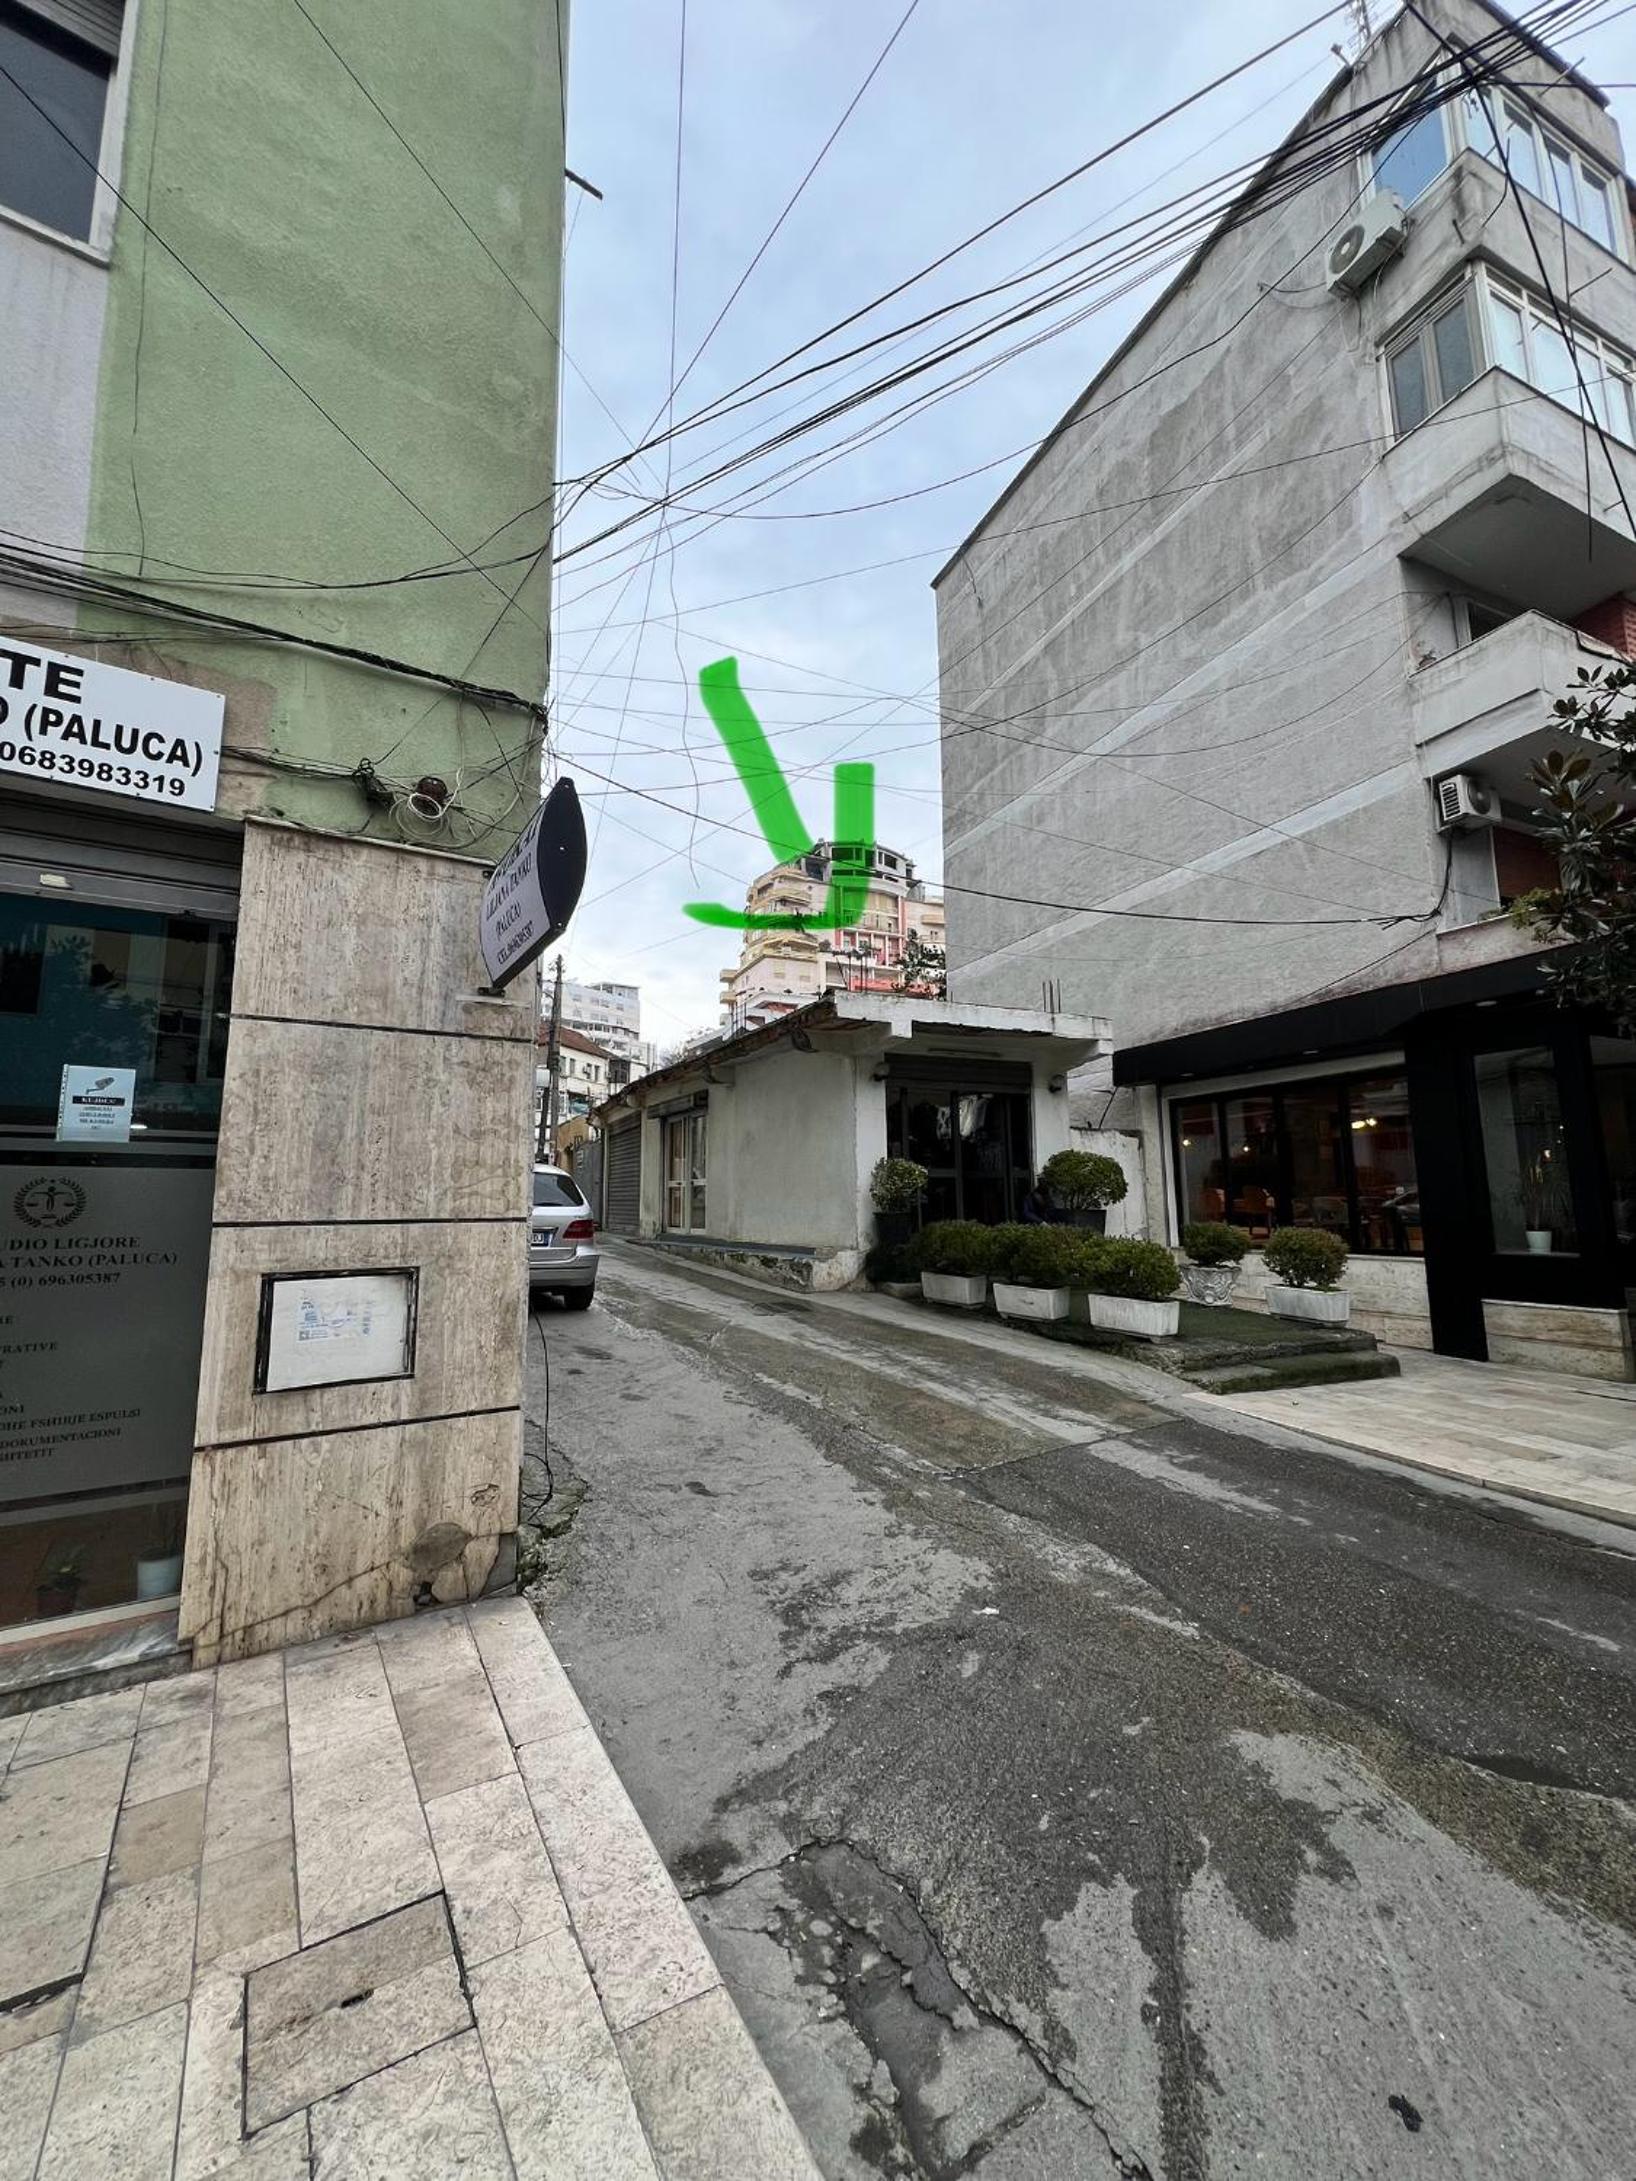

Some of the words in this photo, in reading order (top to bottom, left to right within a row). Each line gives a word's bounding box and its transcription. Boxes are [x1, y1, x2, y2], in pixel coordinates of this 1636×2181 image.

[24, 703, 203, 777] (PALUCA)
[0, 740, 186, 797] 0683983319
[54, 1237, 141, 1250] LIGJORE
[11, 1255, 83, 1268] TANKO
[88, 1252, 177, 1266] (PALUCA)
[11, 1275, 33, 1289] (0)
[0, 1342, 58, 1354] RATIVE
